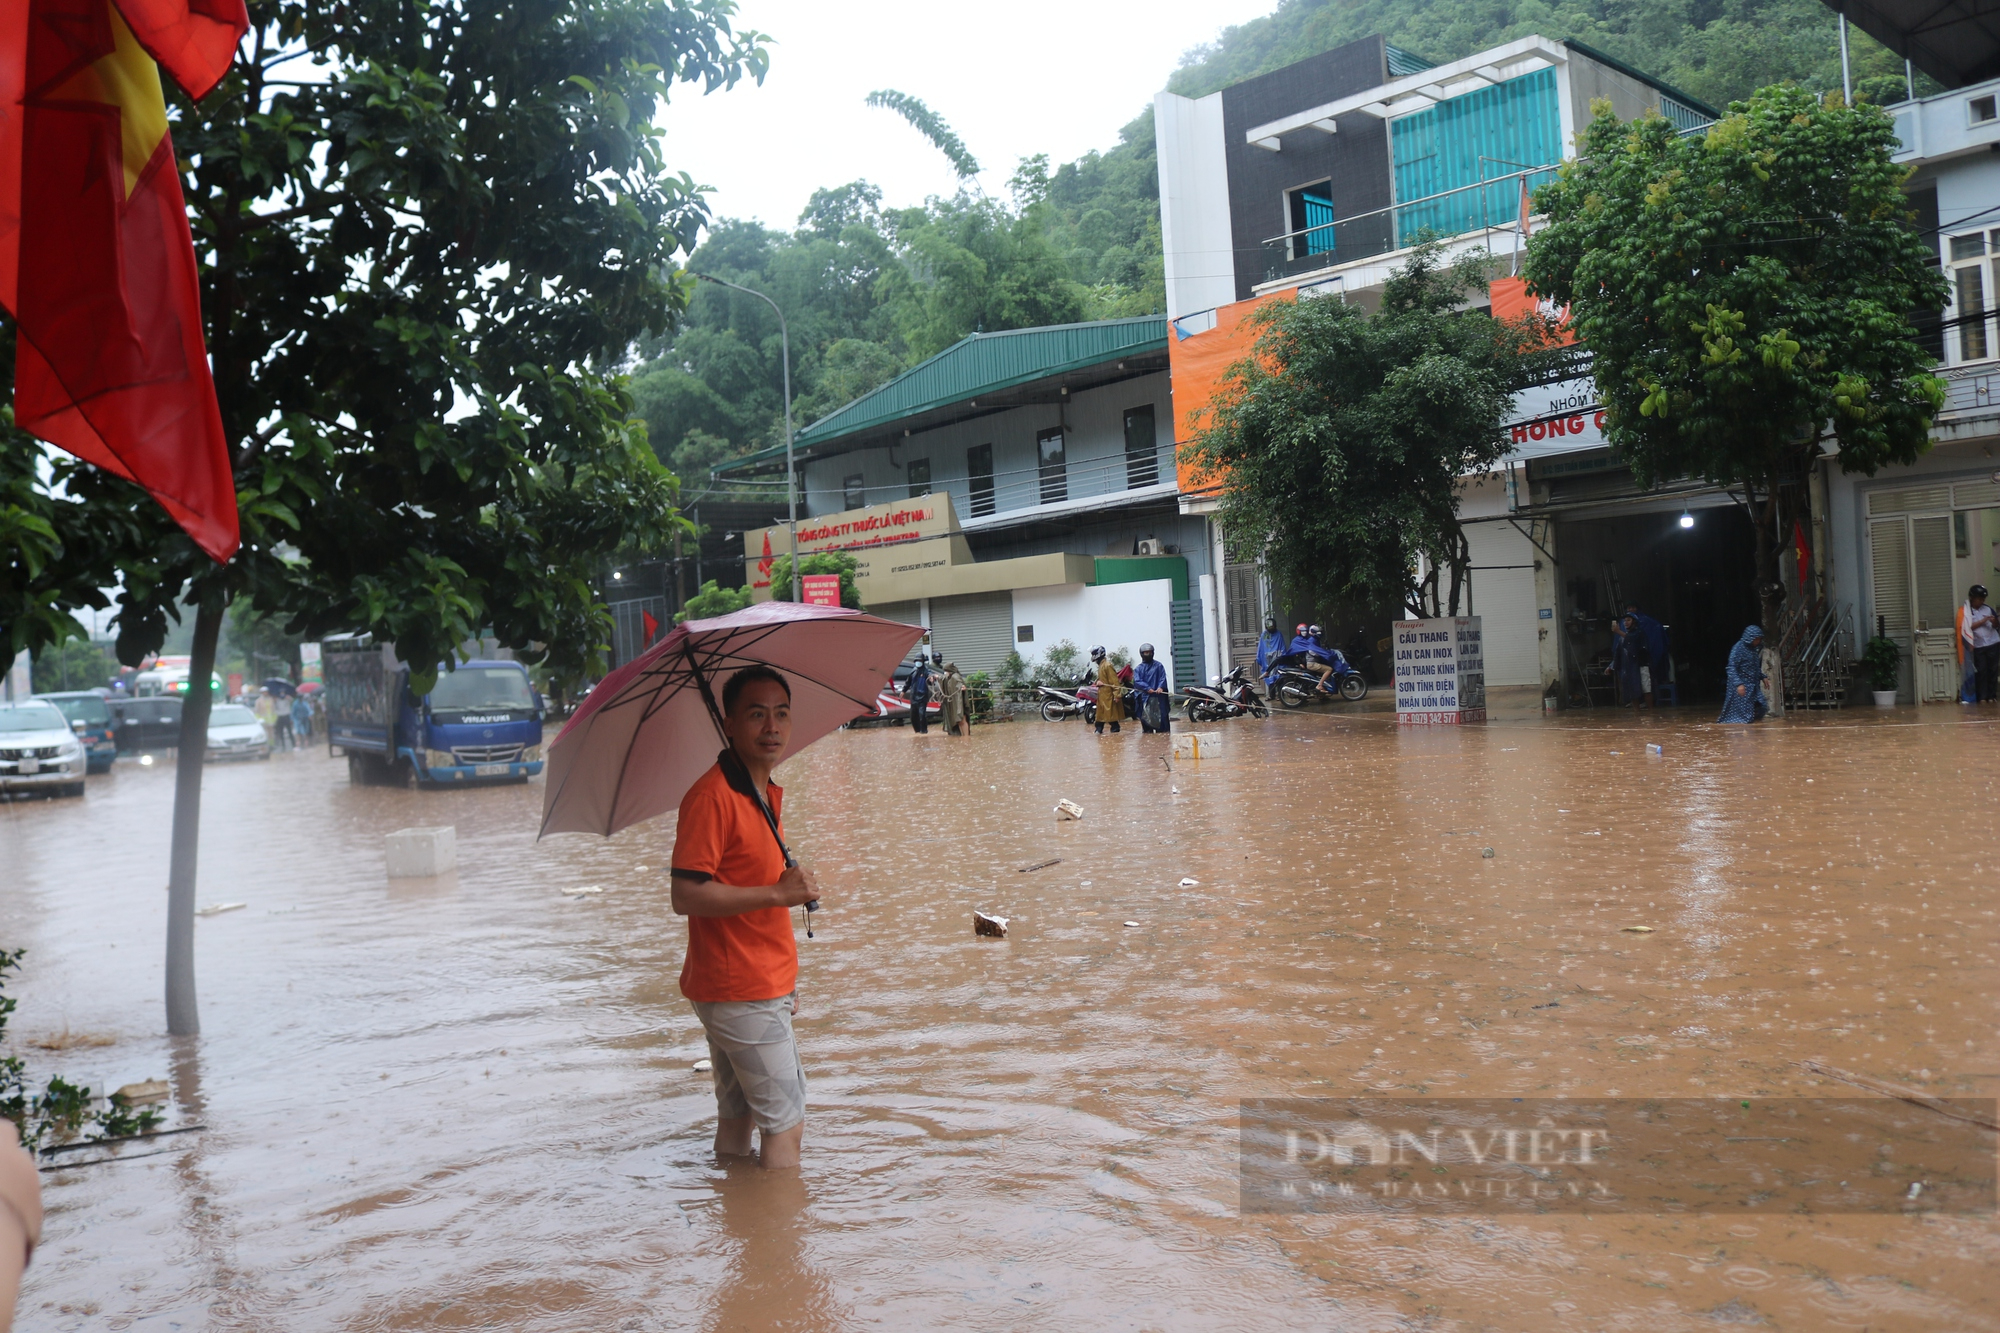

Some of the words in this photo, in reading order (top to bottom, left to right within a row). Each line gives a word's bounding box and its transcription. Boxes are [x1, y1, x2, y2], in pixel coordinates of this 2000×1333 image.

[1550, 394, 1588, 412] NHÔM
[818, 525, 839, 540] CÔNG
[840, 523, 851, 536] TY
[851, 516, 879, 533] THUỐC
[879, 513, 891, 529] LÁ
[891, 510, 910, 526] VIỆT
[911, 508, 934, 523] NAM
[1419, 631, 1449, 643] THANG
[1396, 650, 1412, 660] LAN
[1414, 649, 1431, 659] CAN
[1433, 648, 1453, 659] INOX
[1412, 664, 1436, 676] THANG
[1437, 662, 1455, 675] KÍNH
[1399, 681, 1415, 692] SƠN
[1416, 679, 1434, 692] TĨNH
[1435, 678, 1454, 693] ĐIỆN
[1398, 696, 1420, 710] NHẬN
[1421, 694, 1438, 708] UỐN
[1439, 693, 1456, 708] ỐNG
[1399, 713, 1410, 724] ĐT:
[1411, 713, 1428, 724] 0979
[1429, 712, 1443, 724] 342
[1443, 712, 1457, 724] 577
